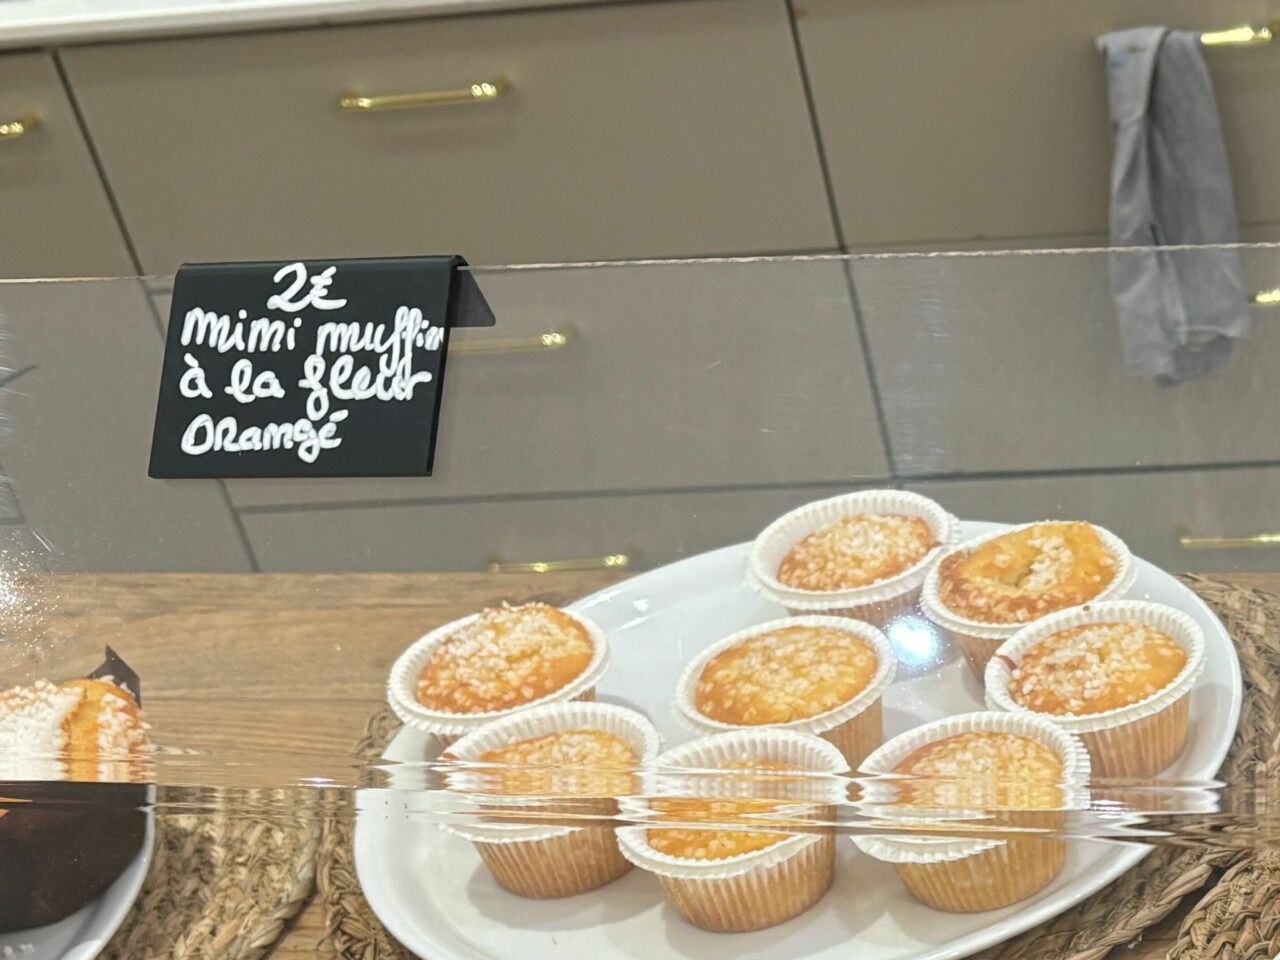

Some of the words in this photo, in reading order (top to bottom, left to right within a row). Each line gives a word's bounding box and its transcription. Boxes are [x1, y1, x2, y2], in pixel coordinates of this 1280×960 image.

[267, 262, 347, 312] 2€
[179, 353, 213, 398] à
[225, 359, 285, 403] la
[299, 354, 432, 420] fleur
